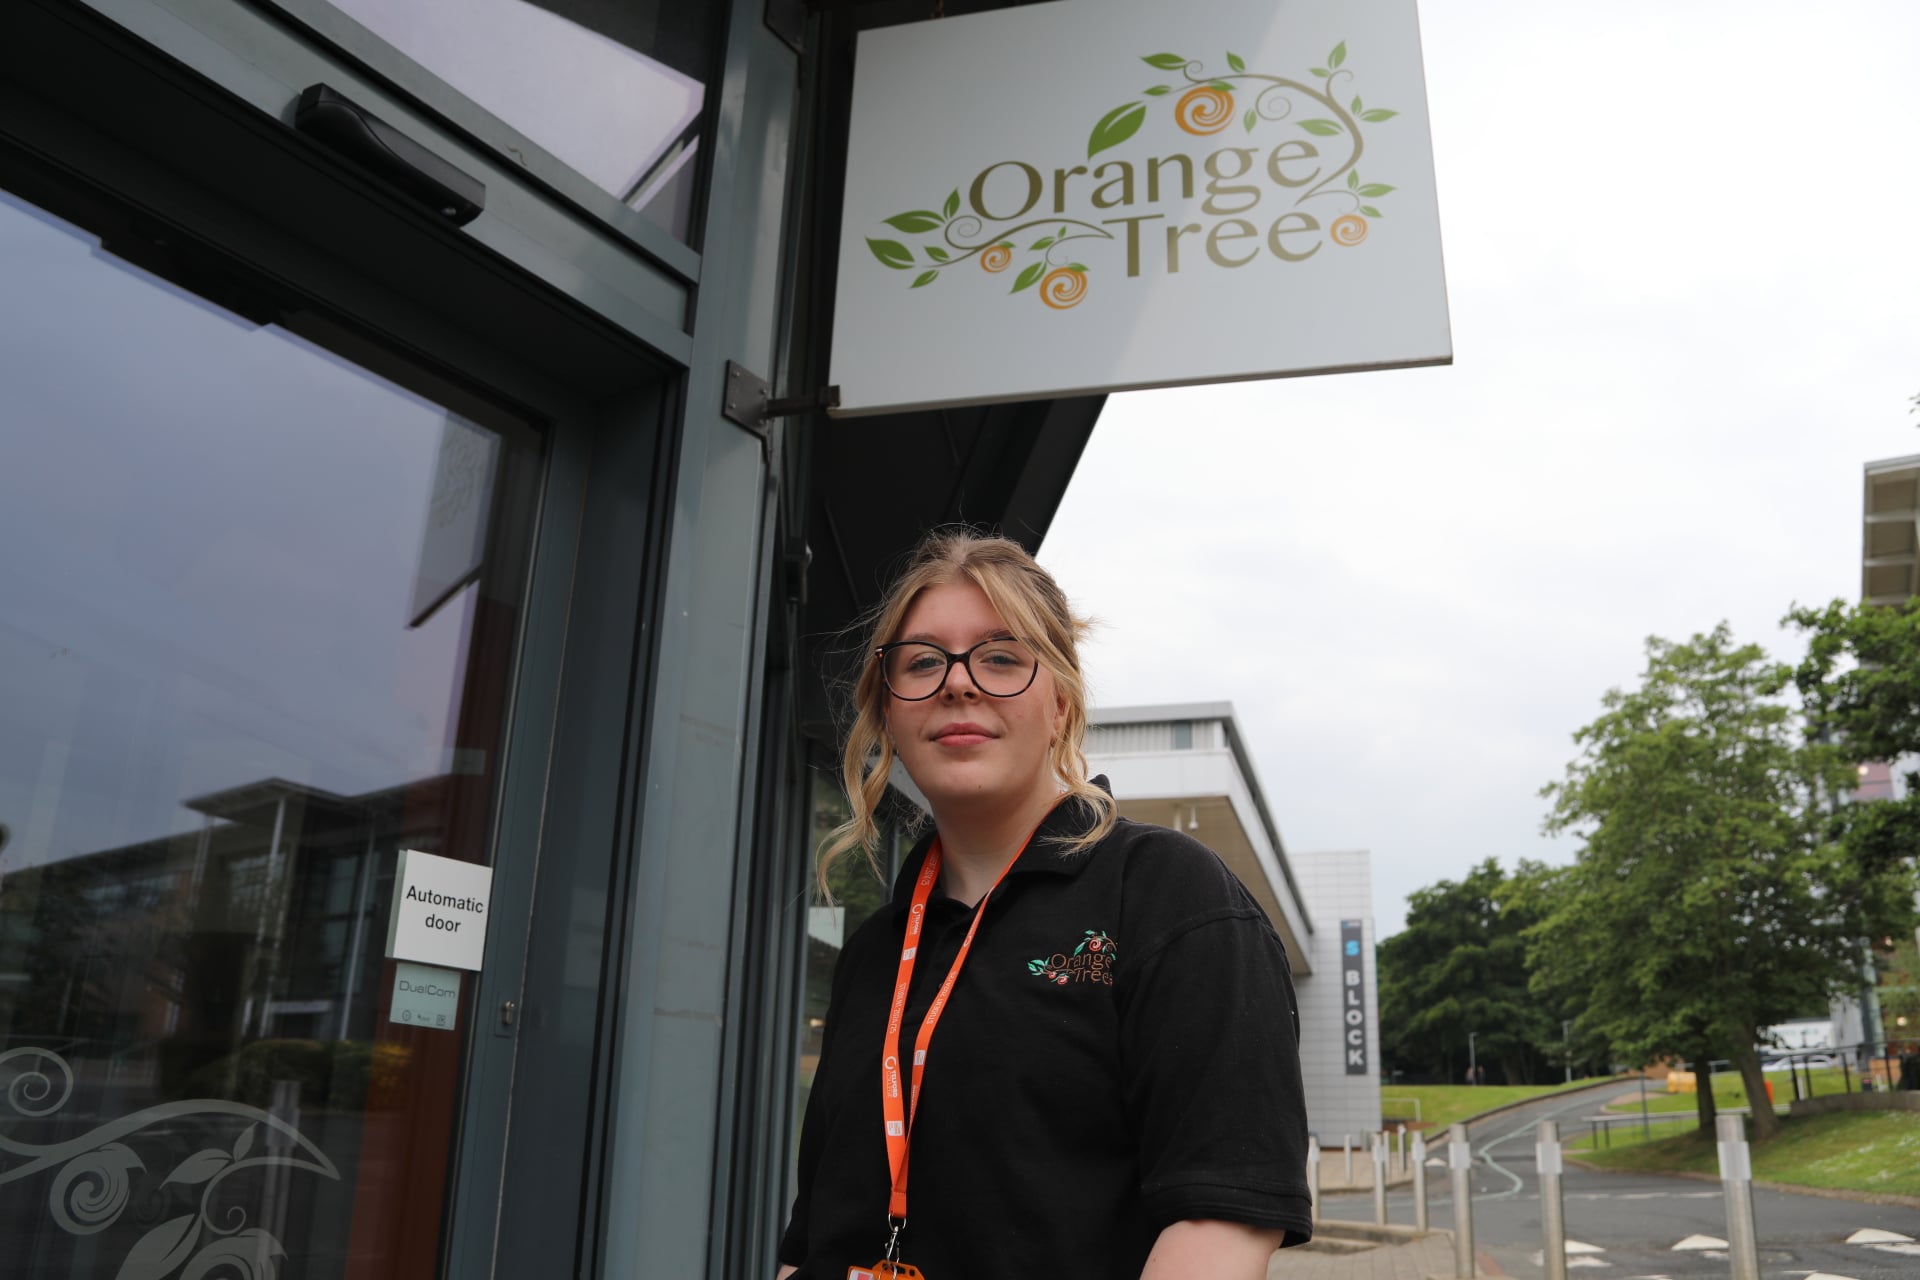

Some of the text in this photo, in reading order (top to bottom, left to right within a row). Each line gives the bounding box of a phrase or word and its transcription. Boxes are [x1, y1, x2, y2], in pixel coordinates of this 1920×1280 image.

[968, 139, 1322, 221] Orange
[1101, 211, 1323, 278] Tree
[406, 885, 484, 914] Automatic
[425, 914, 461, 932] door
[1051, 953, 1112, 970] Orange
[1073, 966, 1109, 985] Tree
[399, 980, 456, 999] DualCom
[1346, 970, 1363, 1065] BLOCK
